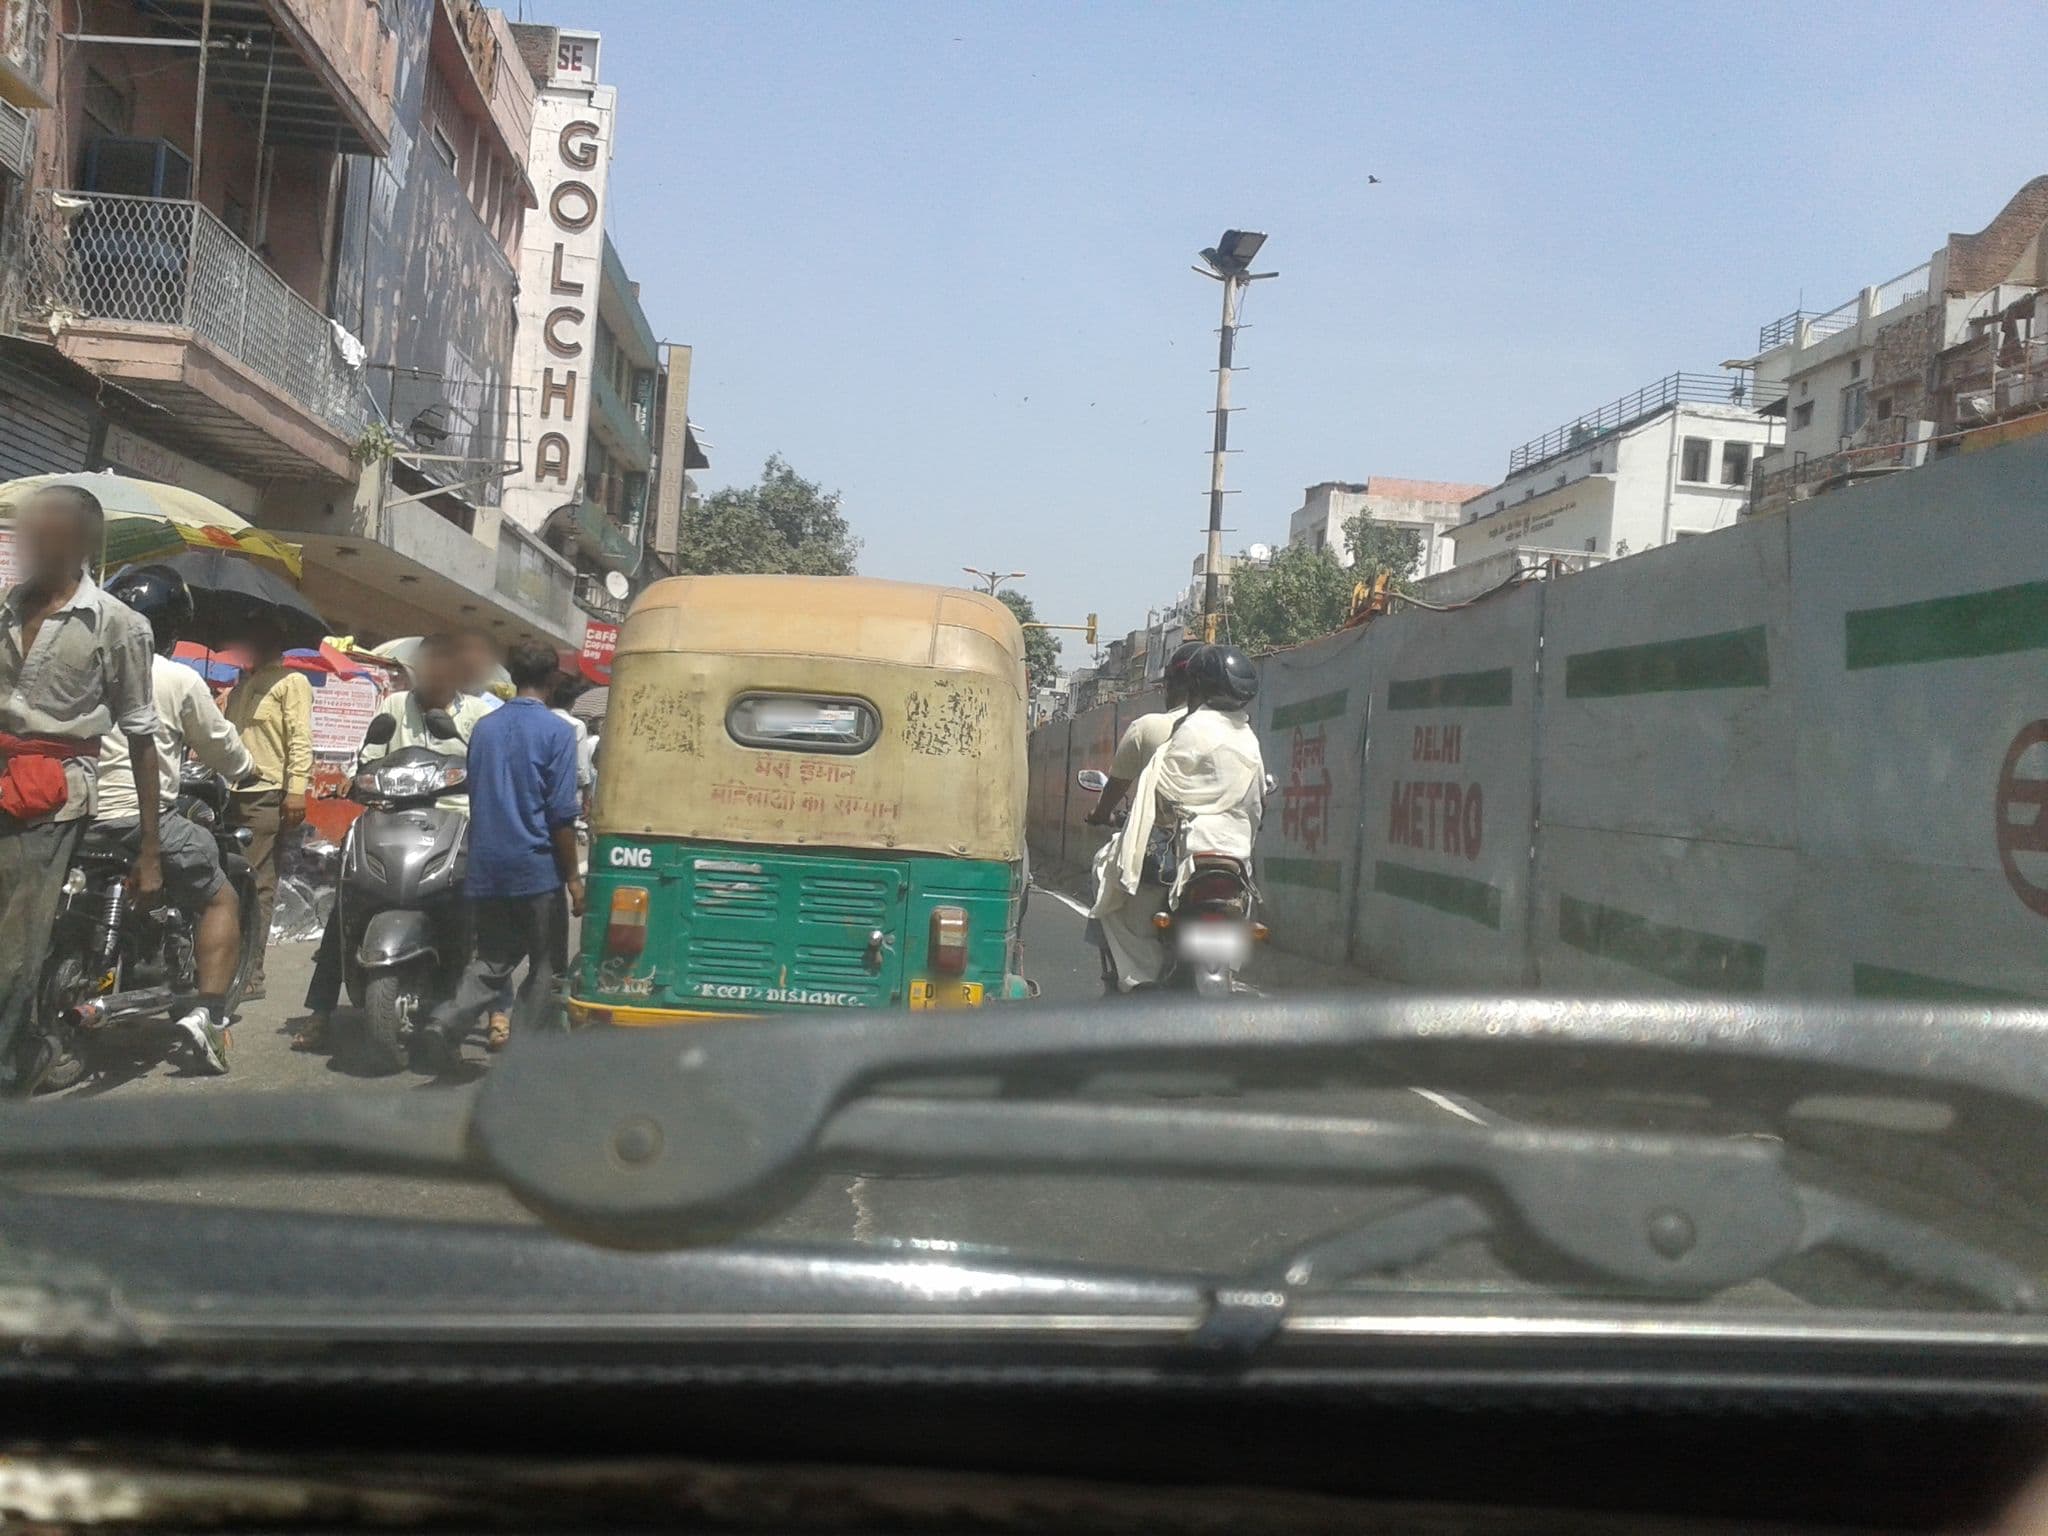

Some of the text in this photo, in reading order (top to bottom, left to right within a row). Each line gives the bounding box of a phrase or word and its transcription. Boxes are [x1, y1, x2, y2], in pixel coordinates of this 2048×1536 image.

[535, 120, 600, 485] GOLCHA
[1412, 724, 1462, 764] DELHI
[1389, 780, 1483, 861] METRO
[610, 847, 652, 868] CNG
